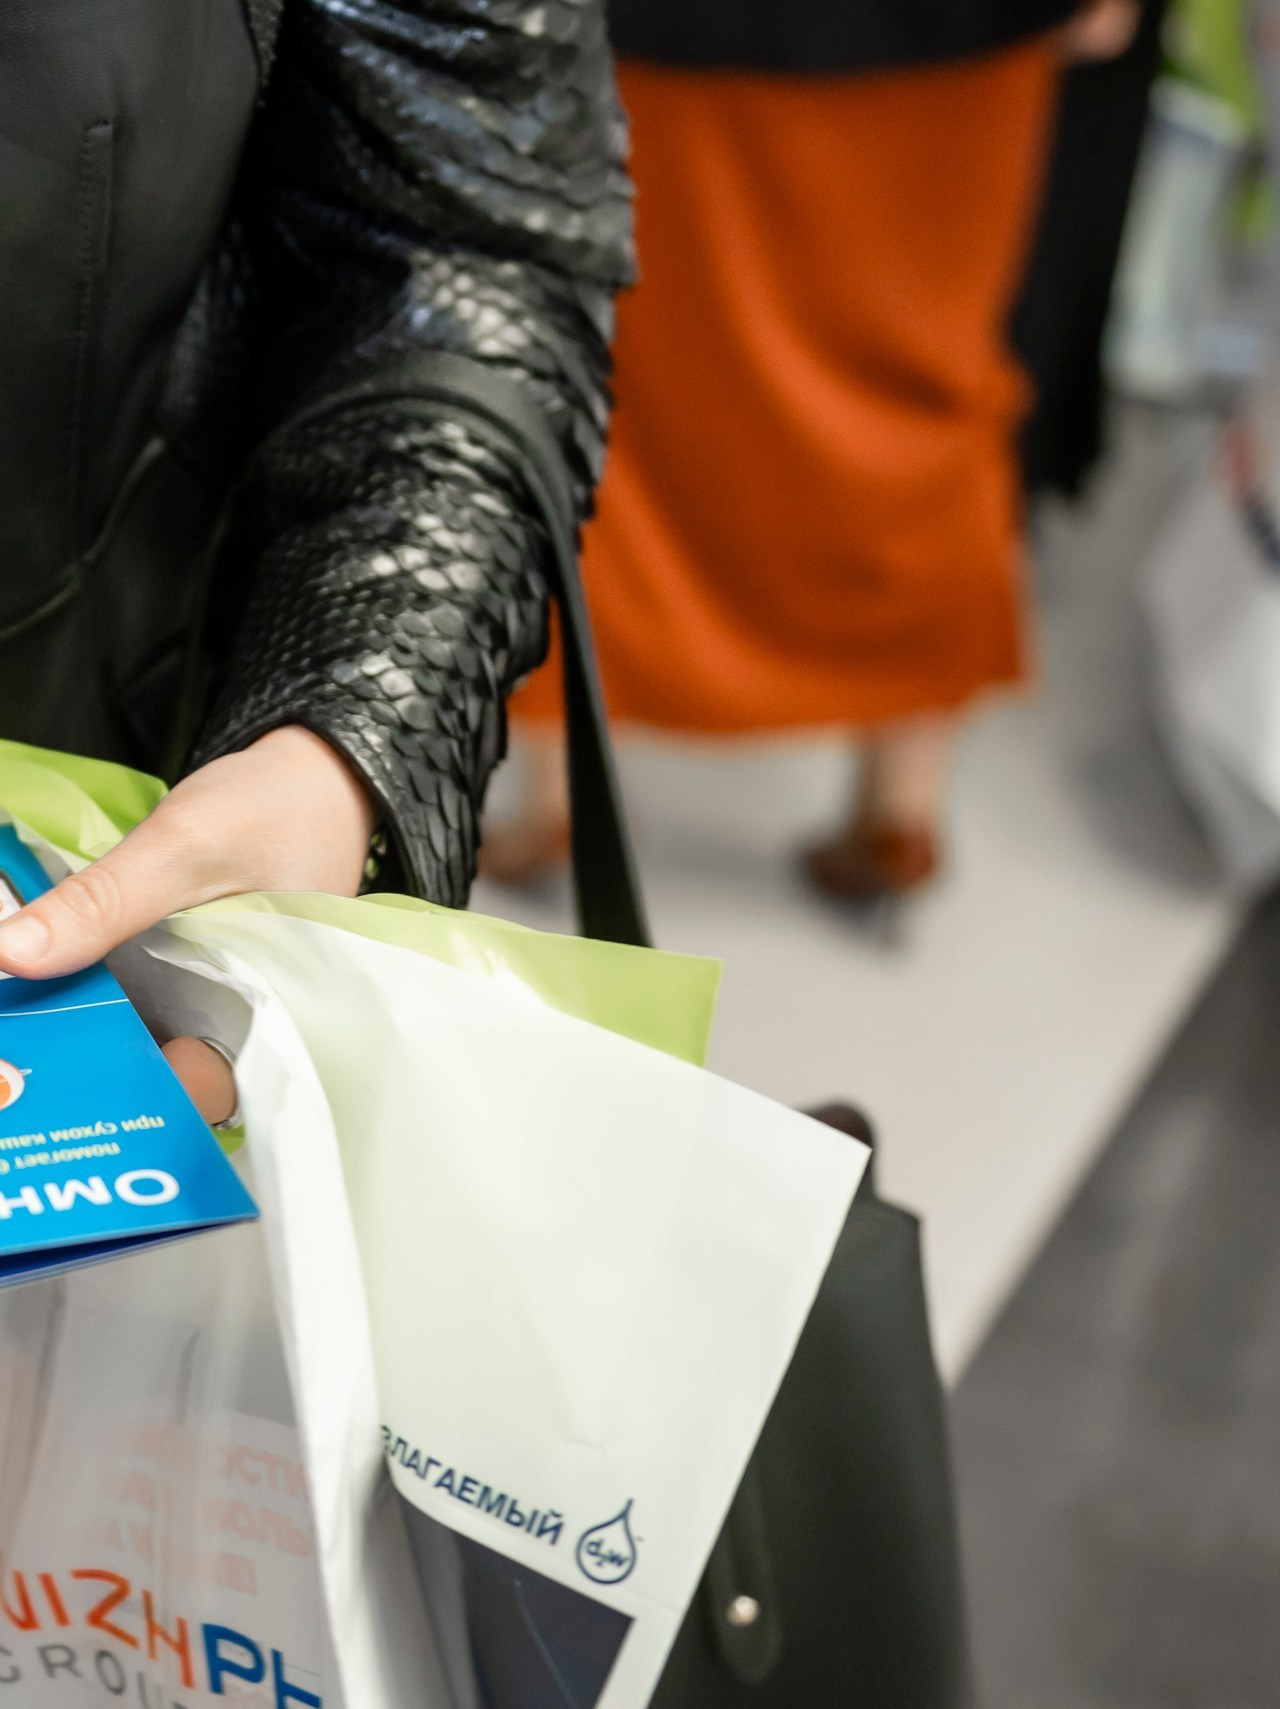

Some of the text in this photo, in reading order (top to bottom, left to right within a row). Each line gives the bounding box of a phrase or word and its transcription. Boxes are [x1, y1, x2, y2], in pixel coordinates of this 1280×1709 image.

[49, 1120, 118, 1143] сухом
[121, 1114, 165, 1132] при
[14, 1142, 121, 1169] помогает
